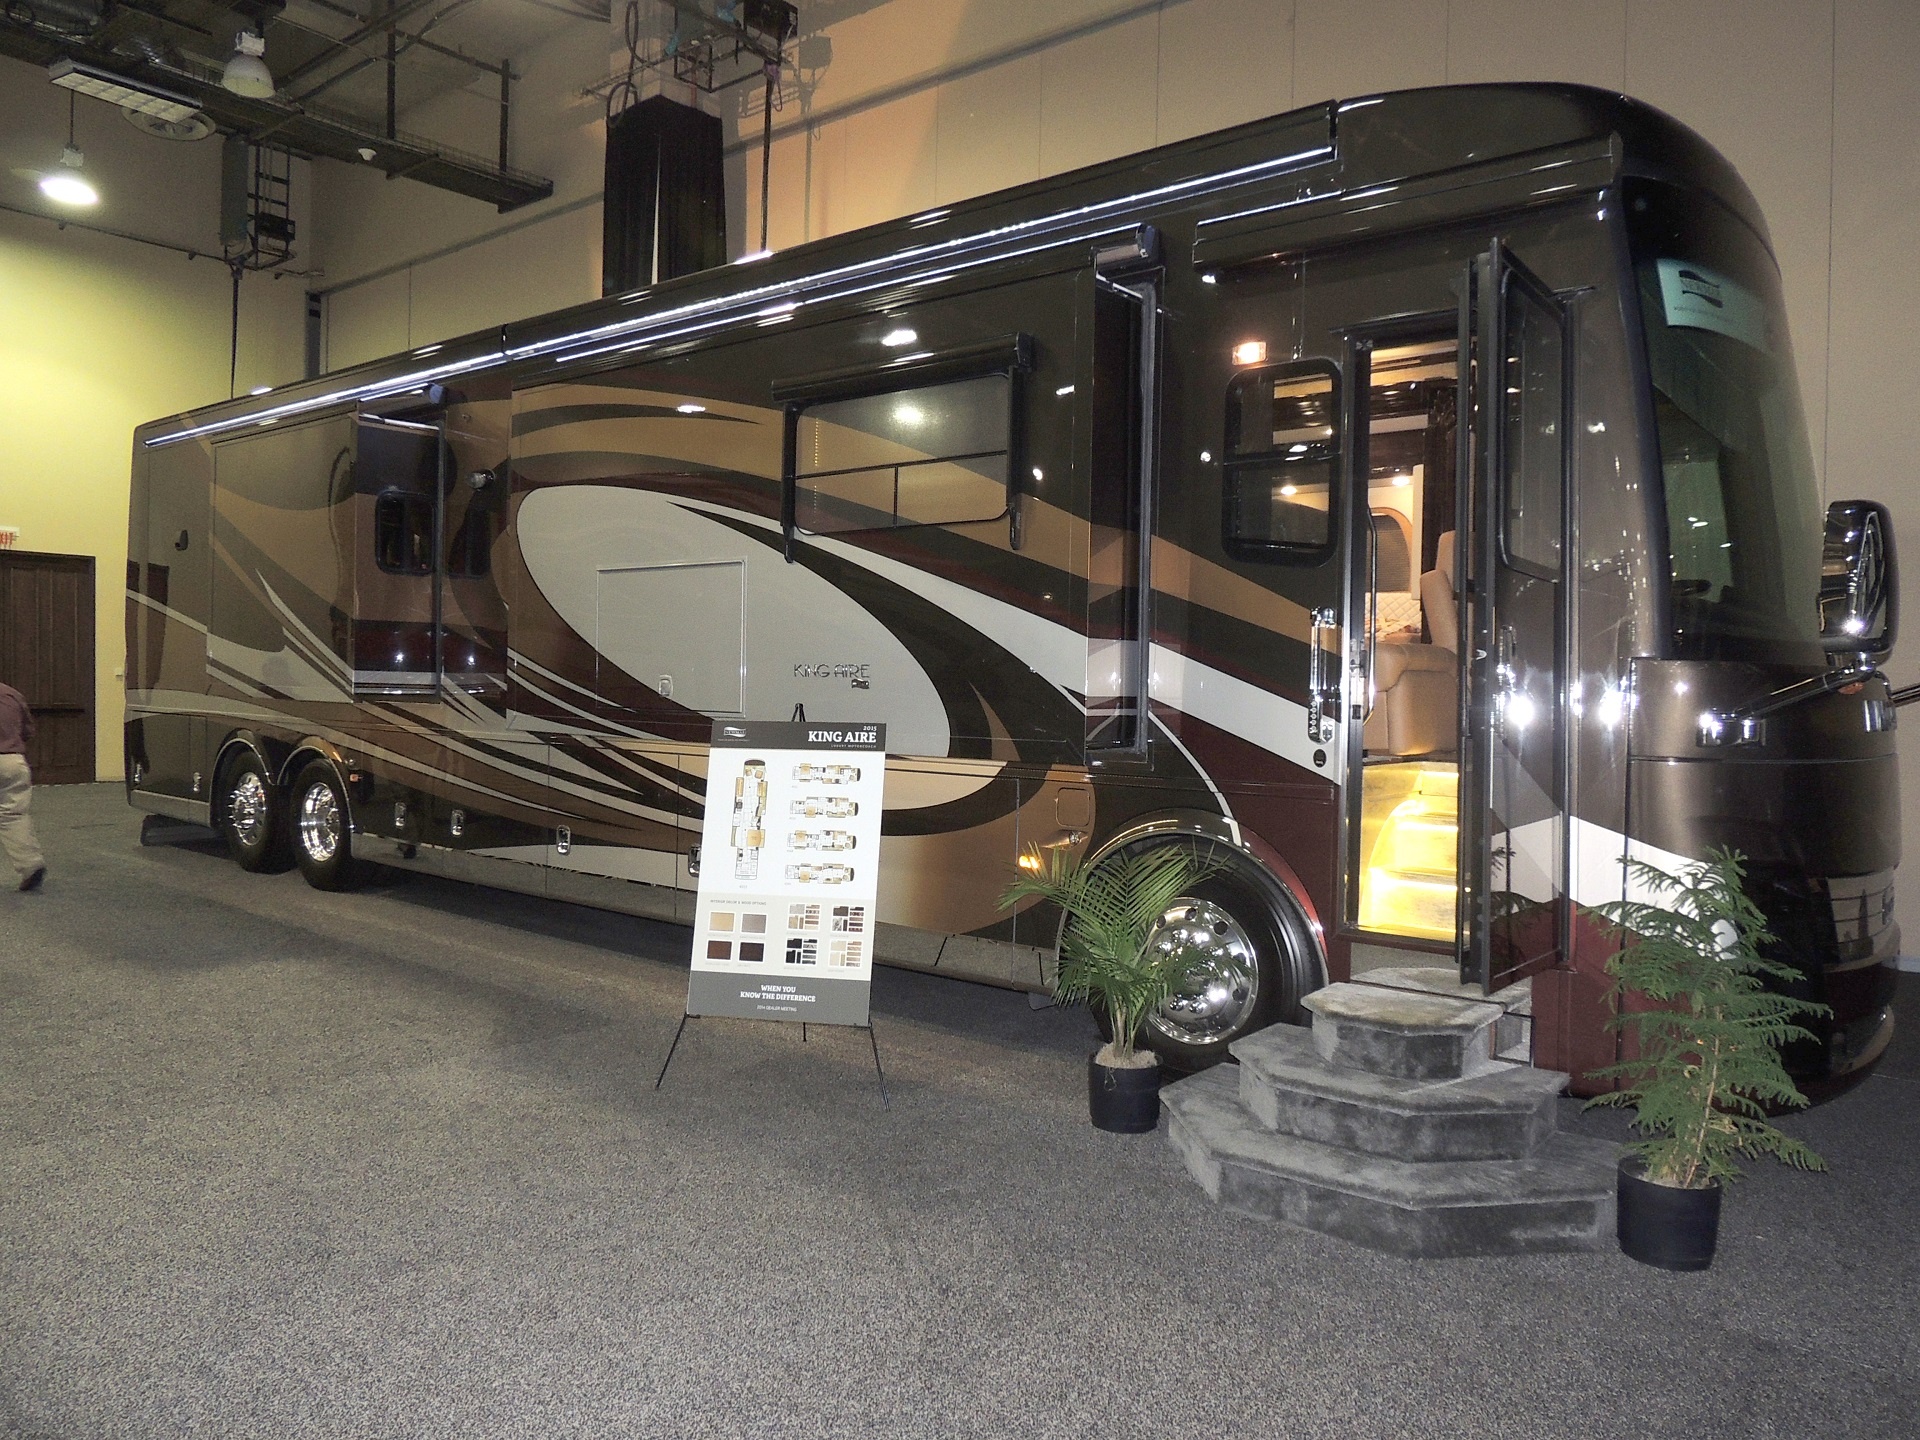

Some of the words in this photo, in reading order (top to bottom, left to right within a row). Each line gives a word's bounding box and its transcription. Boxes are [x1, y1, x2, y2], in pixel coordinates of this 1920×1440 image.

[794, 664, 830, 678] KING
[834, 664, 870, 678] AIRE
[808, 731, 843, 743] KING
[844, 731, 877, 743] AIRE
[761, 984, 782, 993] WHEN
[740, 991, 761, 999] KNOW
[762, 992, 776, 1000] THE
[776, 993, 816, 1003] DIFFERENCE
